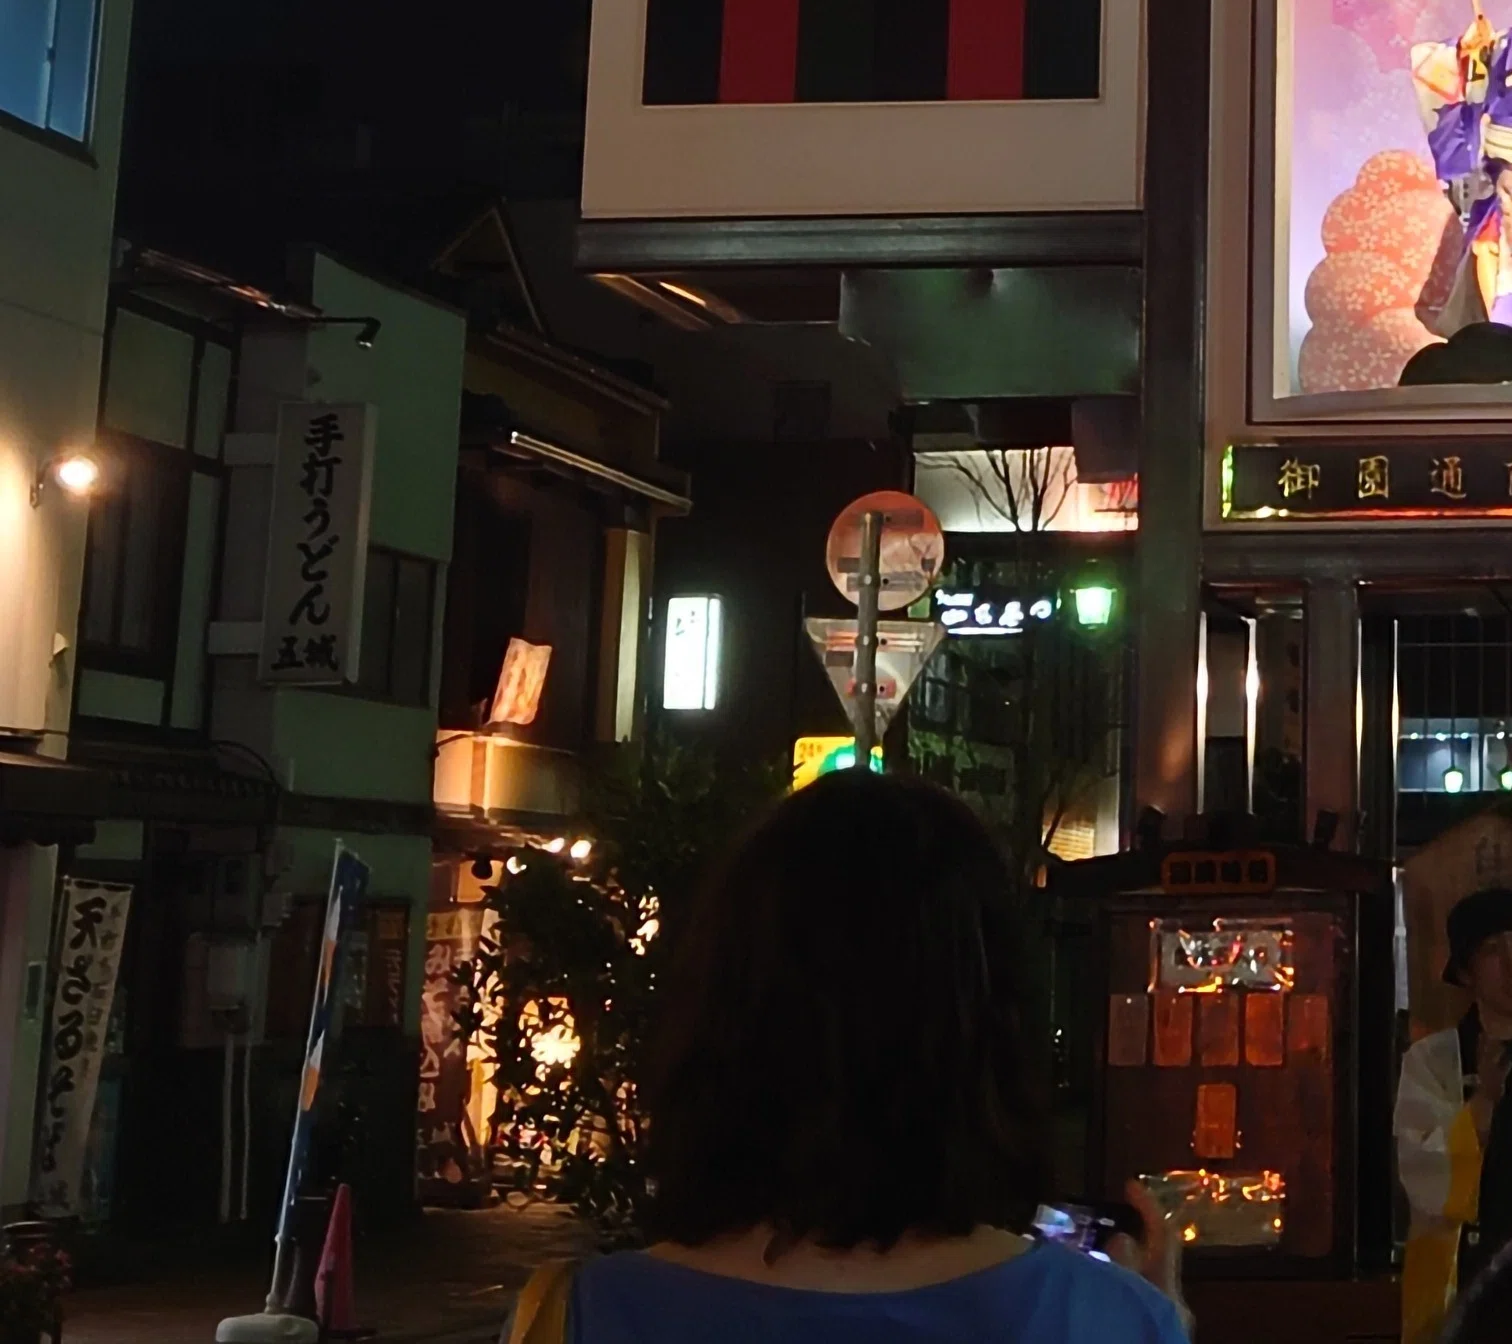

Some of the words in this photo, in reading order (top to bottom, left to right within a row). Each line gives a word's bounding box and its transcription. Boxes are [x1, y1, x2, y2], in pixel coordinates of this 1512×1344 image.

[287, 412, 345, 626] 手打うどん
